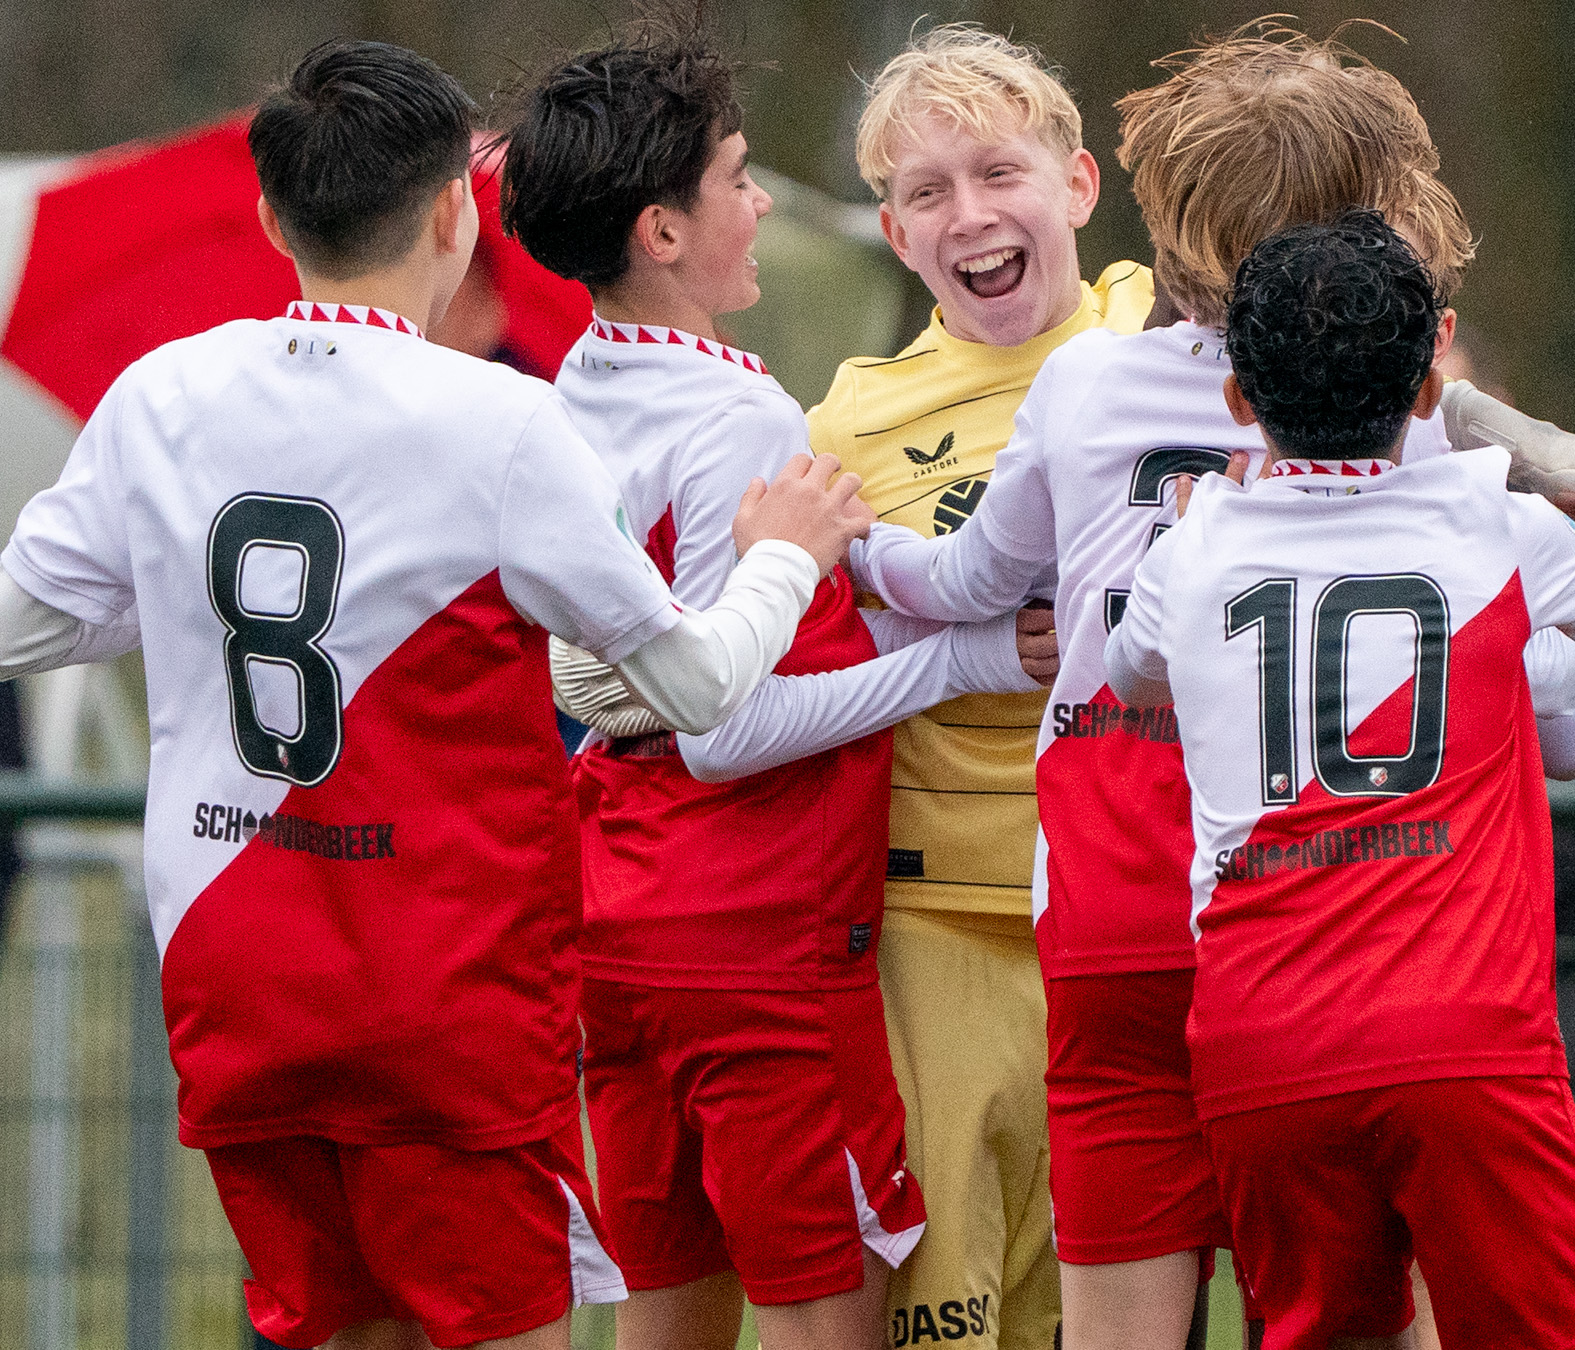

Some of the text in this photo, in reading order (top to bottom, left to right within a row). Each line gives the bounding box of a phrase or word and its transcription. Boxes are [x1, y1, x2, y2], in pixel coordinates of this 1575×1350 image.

[913, 456, 959, 479] CASTORE
[206, 491, 345, 788] 8
[1224, 572, 1451, 807] 10
[1214, 820, 1455, 882] SCHOONDERBEEK
